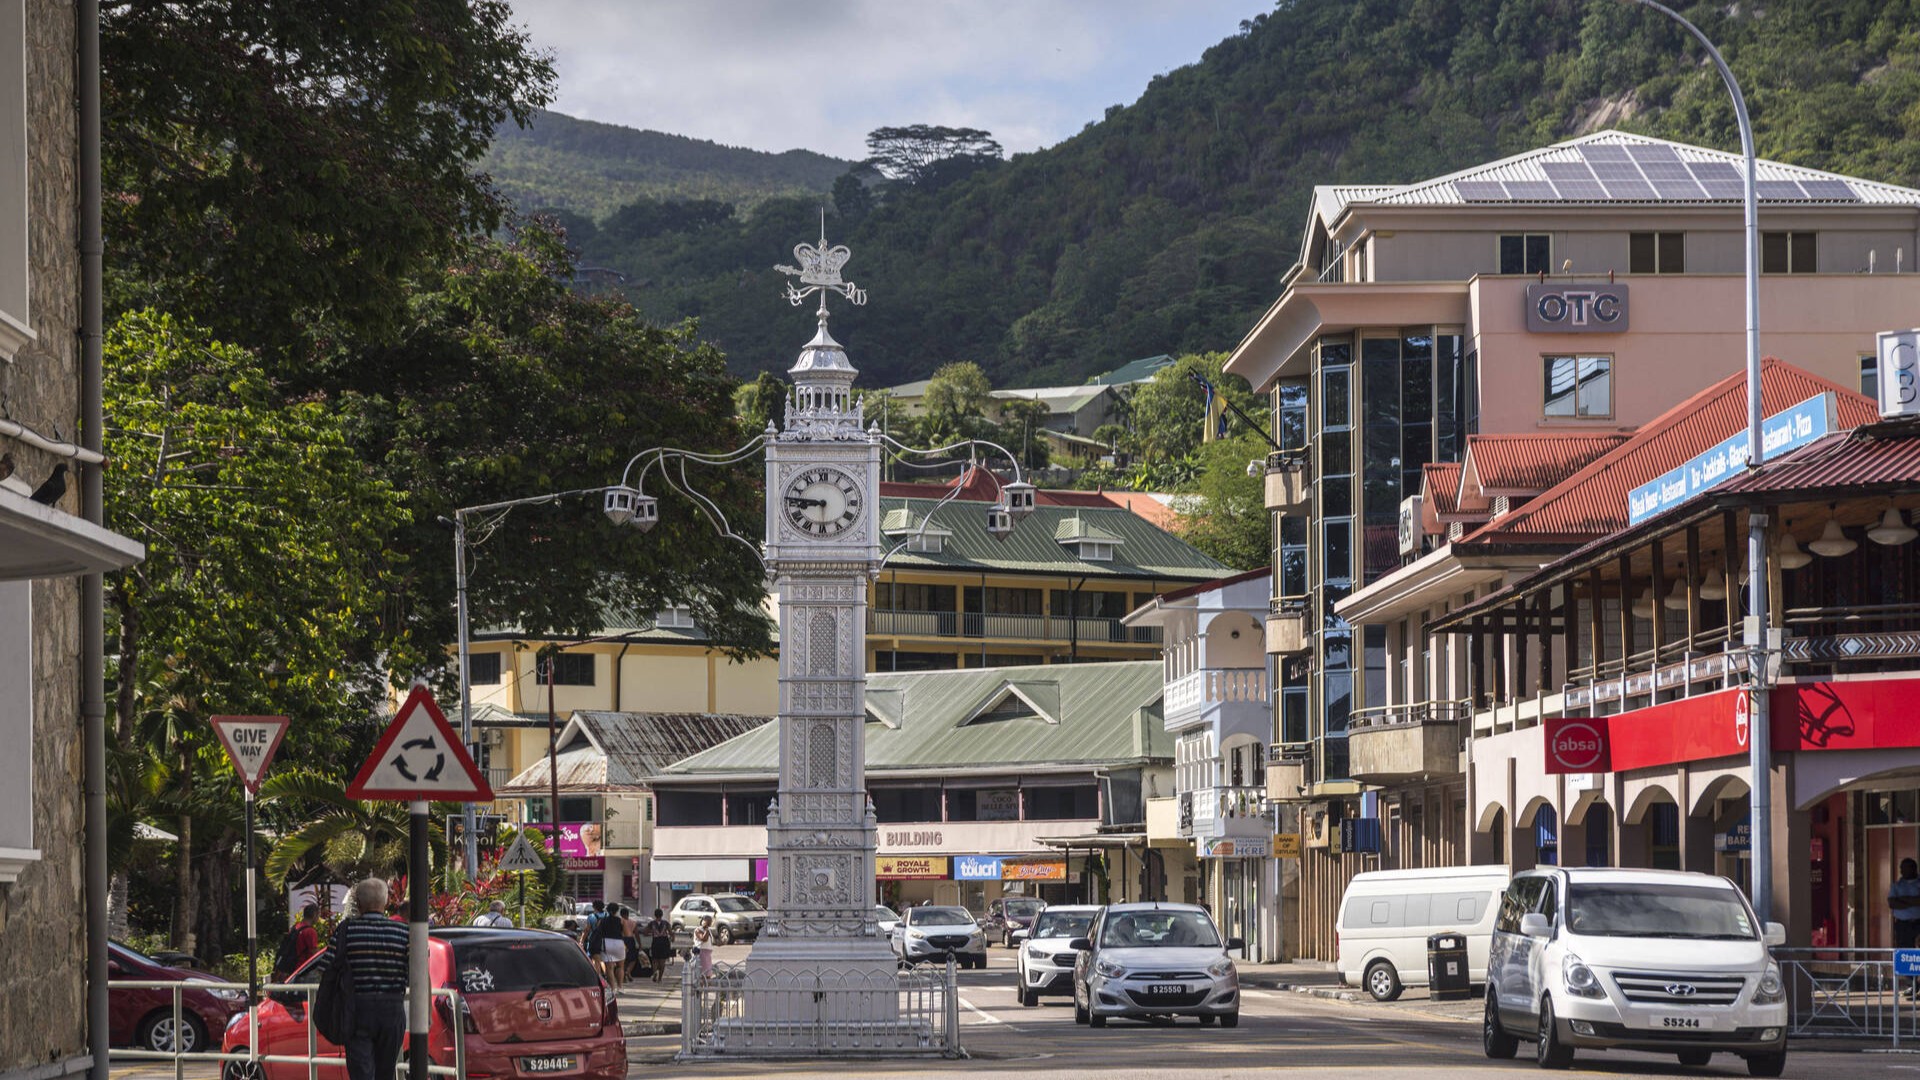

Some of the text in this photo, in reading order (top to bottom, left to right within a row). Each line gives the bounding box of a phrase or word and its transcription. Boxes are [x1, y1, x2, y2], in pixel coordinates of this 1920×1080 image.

[1538, 291, 1621, 325] OTC
[233, 728, 267, 743] GIVE
[240, 745, 262, 756] WAY
[1559, 736, 1596, 751] absa
[886, 831, 943, 846] BUILDING
[1663, 1017, 1699, 1028] S5244
[530, 1057, 569, 1070] S29445
